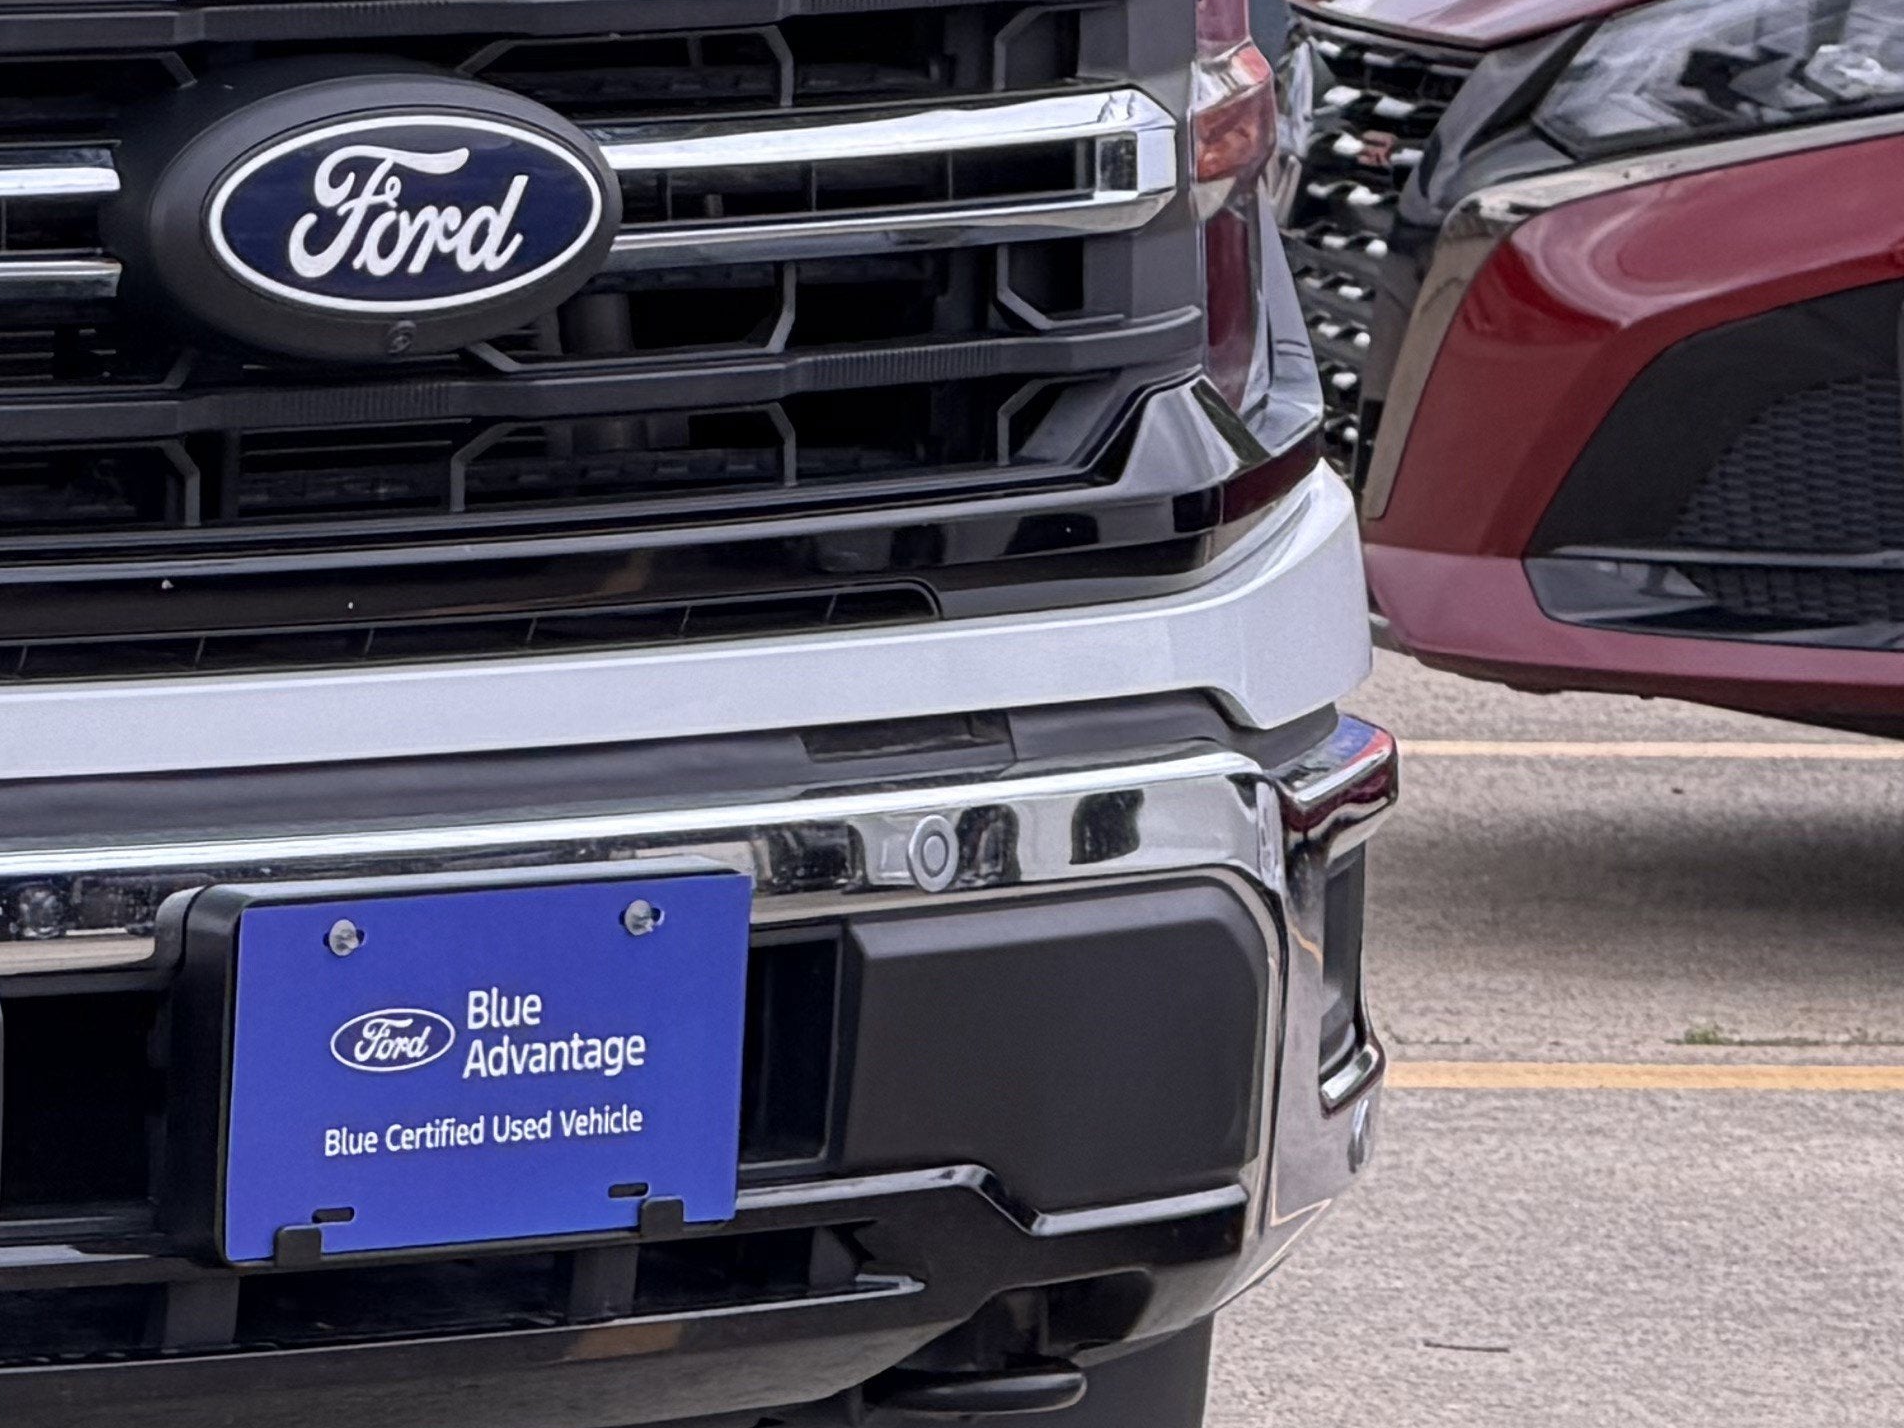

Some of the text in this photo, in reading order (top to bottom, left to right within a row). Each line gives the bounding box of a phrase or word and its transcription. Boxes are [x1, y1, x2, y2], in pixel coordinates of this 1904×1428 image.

[288, 144, 529, 279] Ford
[467, 987, 542, 1030] Blue
[353, 1017, 431, 1062] Ford
[462, 1032, 646, 1079] Advantage
[324, 1103, 643, 1157] Blue Certified Used Vehicle
